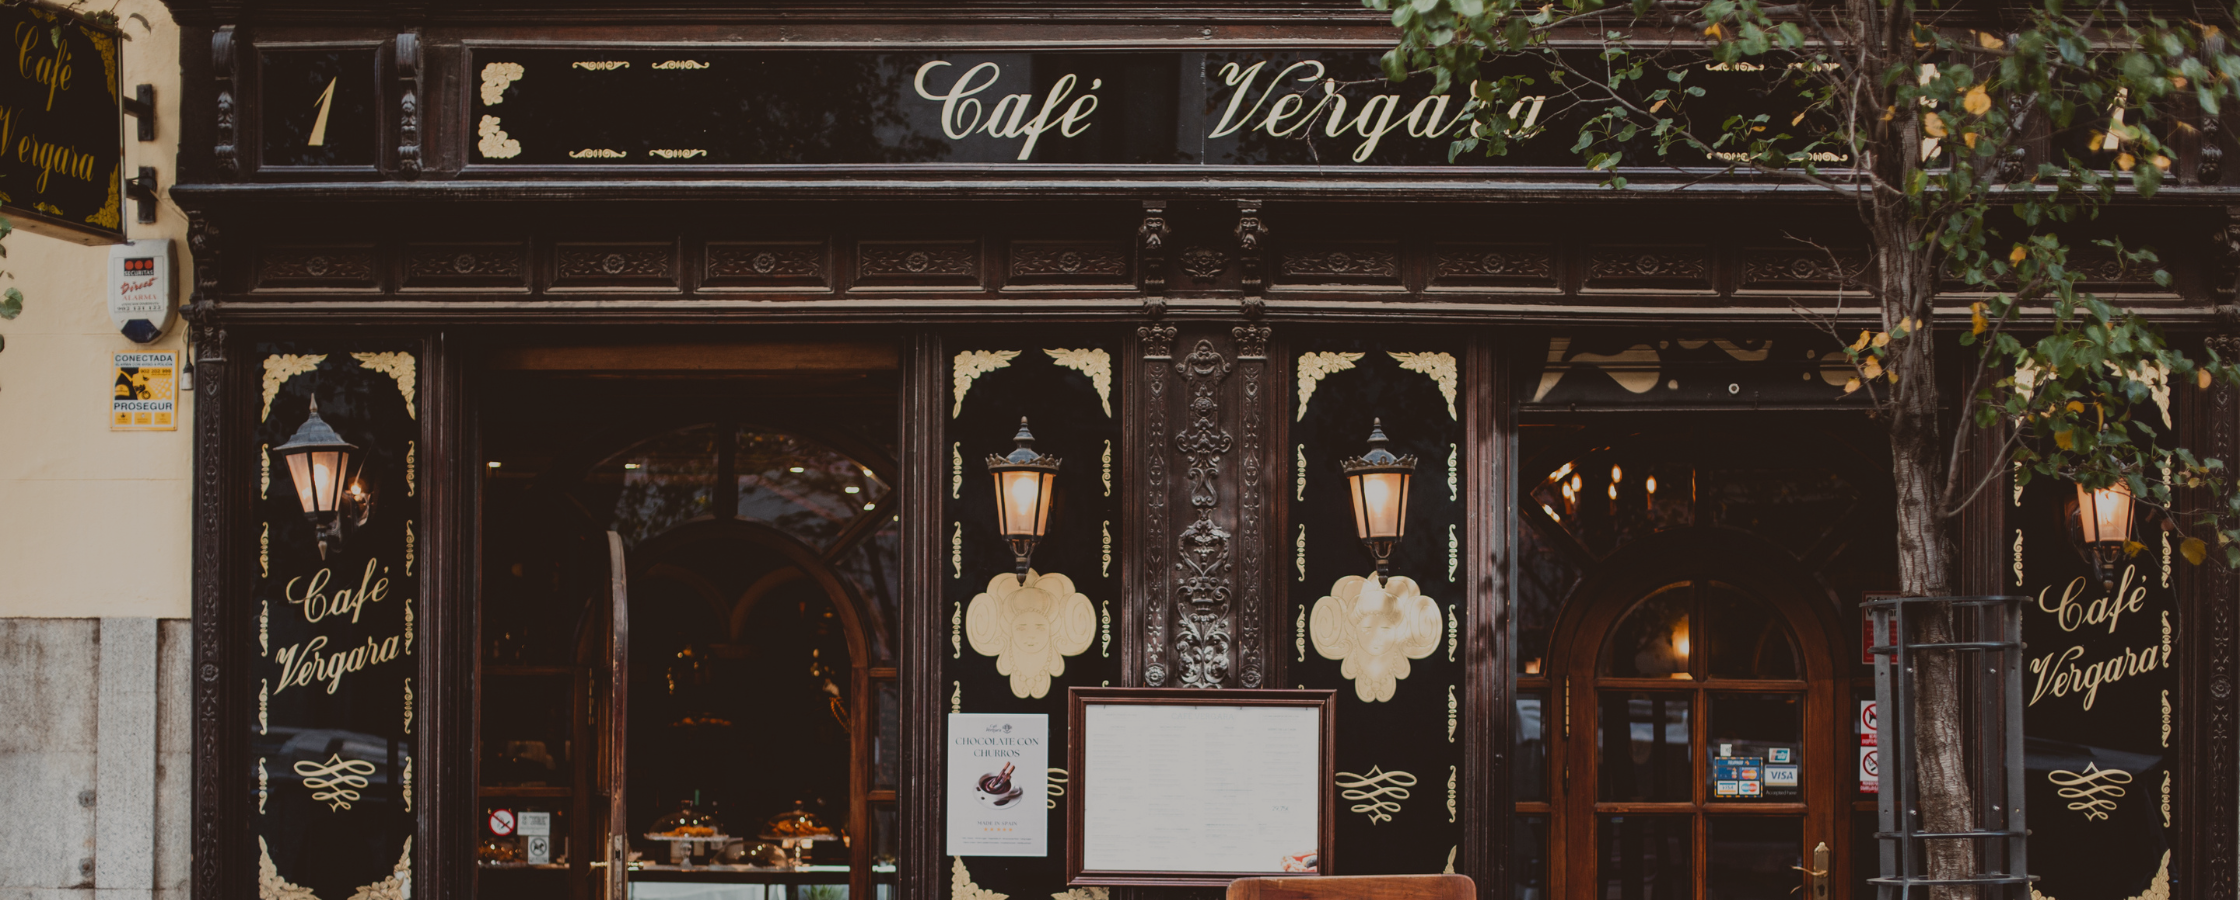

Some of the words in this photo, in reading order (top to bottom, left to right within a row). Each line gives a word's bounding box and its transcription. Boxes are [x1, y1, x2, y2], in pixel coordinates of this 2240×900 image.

[15, 21, 72, 111] Café
[308, 76, 337, 146] 1
[914, 60, 1102, 161] Café
[0, 105, 95, 194] Vergara
[121, 277, 158, 295] Direct
[114, 354, 173, 362] CONECTADA
[114, 402, 172, 411] PROSEGUR
[286, 557, 389, 624] Café
[2038, 564, 2147, 634] Café
[273, 635, 399, 695] Vergara
[2028, 645, 2159, 711] Vergara
[955, 737, 1015, 745] CHOCOLATE
[1016, 737, 1039, 746] CON
[973, 749, 1020, 758] CHURROS
[1770, 771, 1794, 780] VISA
